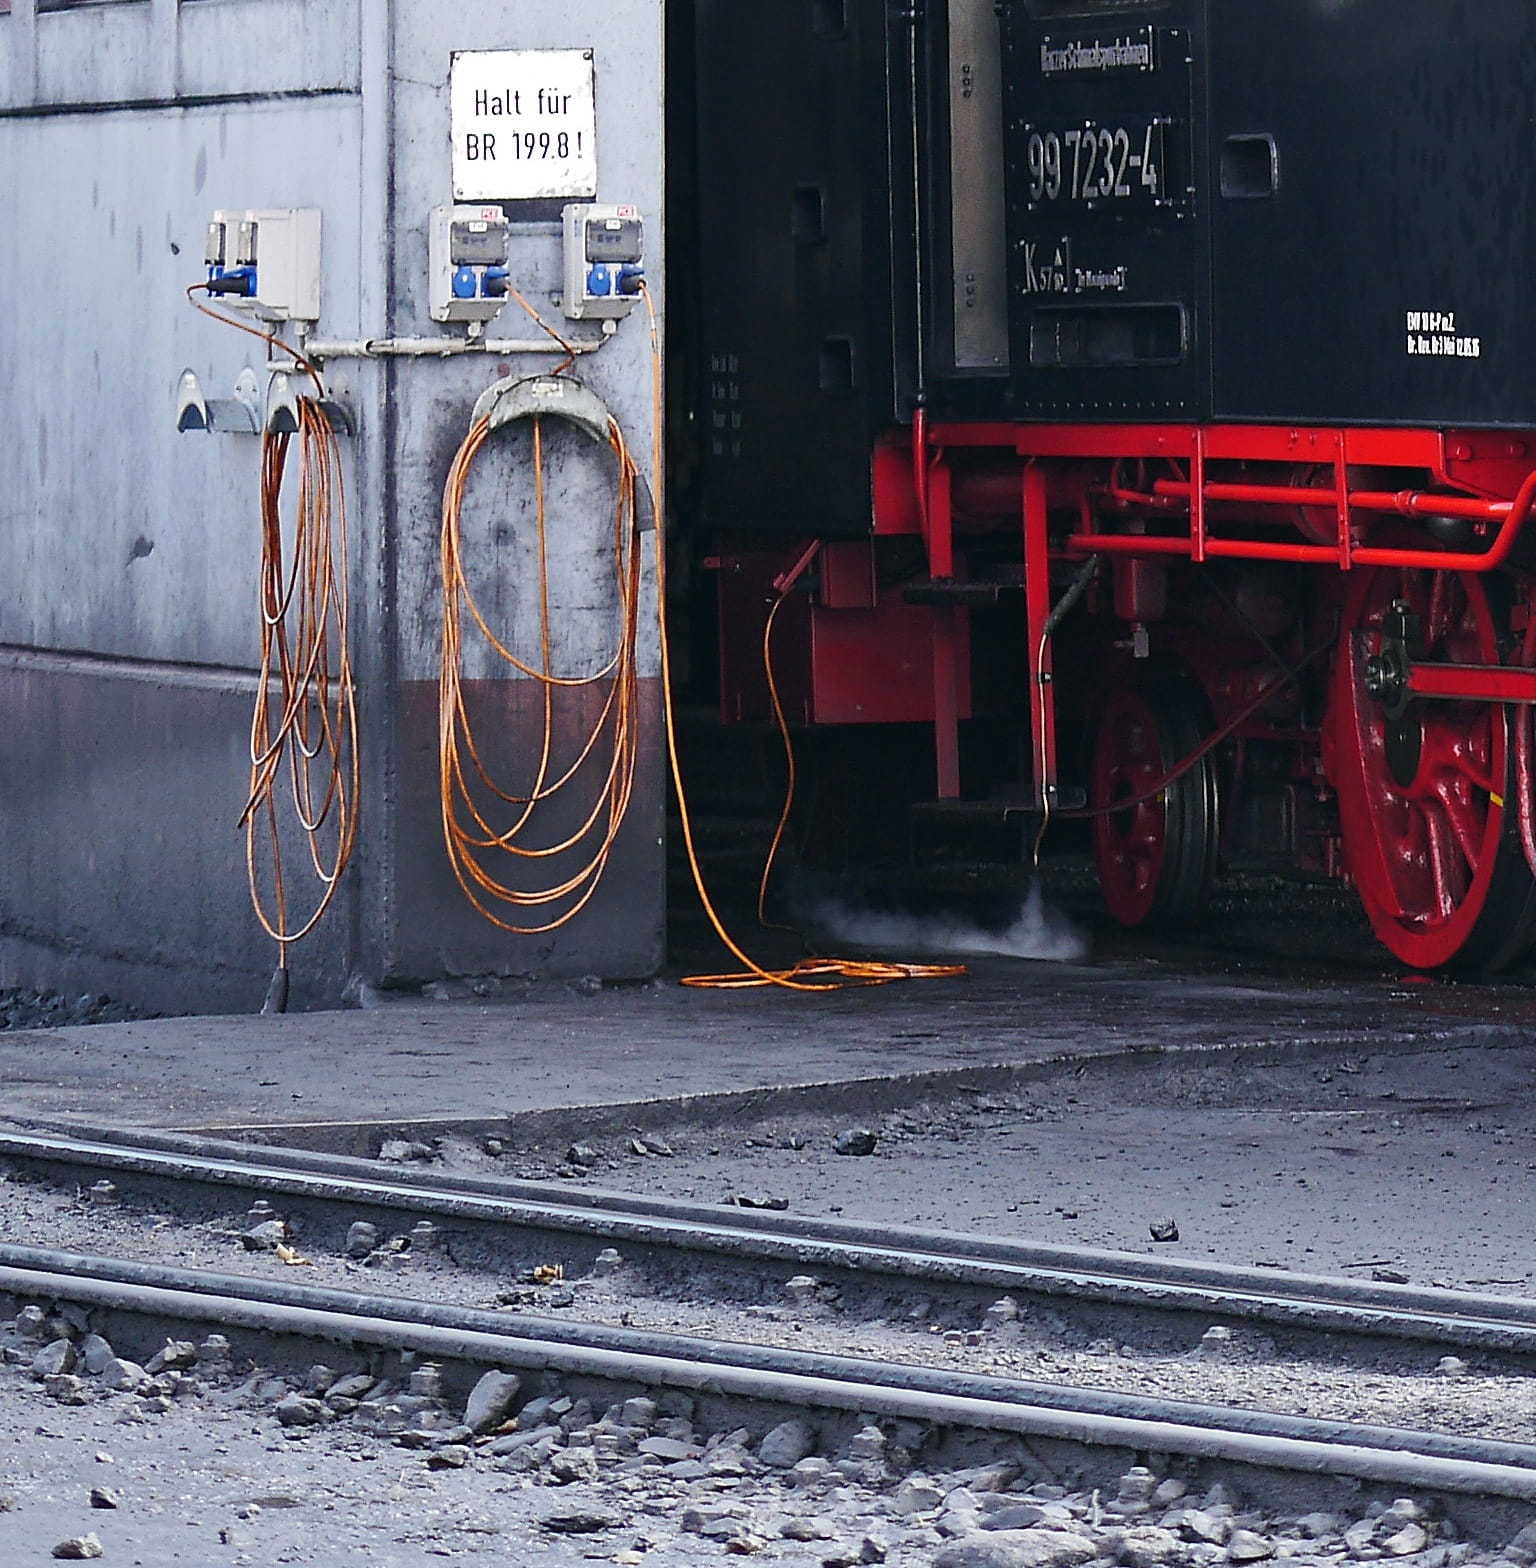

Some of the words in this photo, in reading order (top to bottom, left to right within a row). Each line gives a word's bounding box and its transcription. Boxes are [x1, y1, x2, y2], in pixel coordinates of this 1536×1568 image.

[475, 89, 522, 116] Halt
[538, 87, 572, 116] für
[466, 133, 496, 161] BR
[1028, 130, 1061, 201] 99
[1065, 124, 1158, 201] 7232-4
